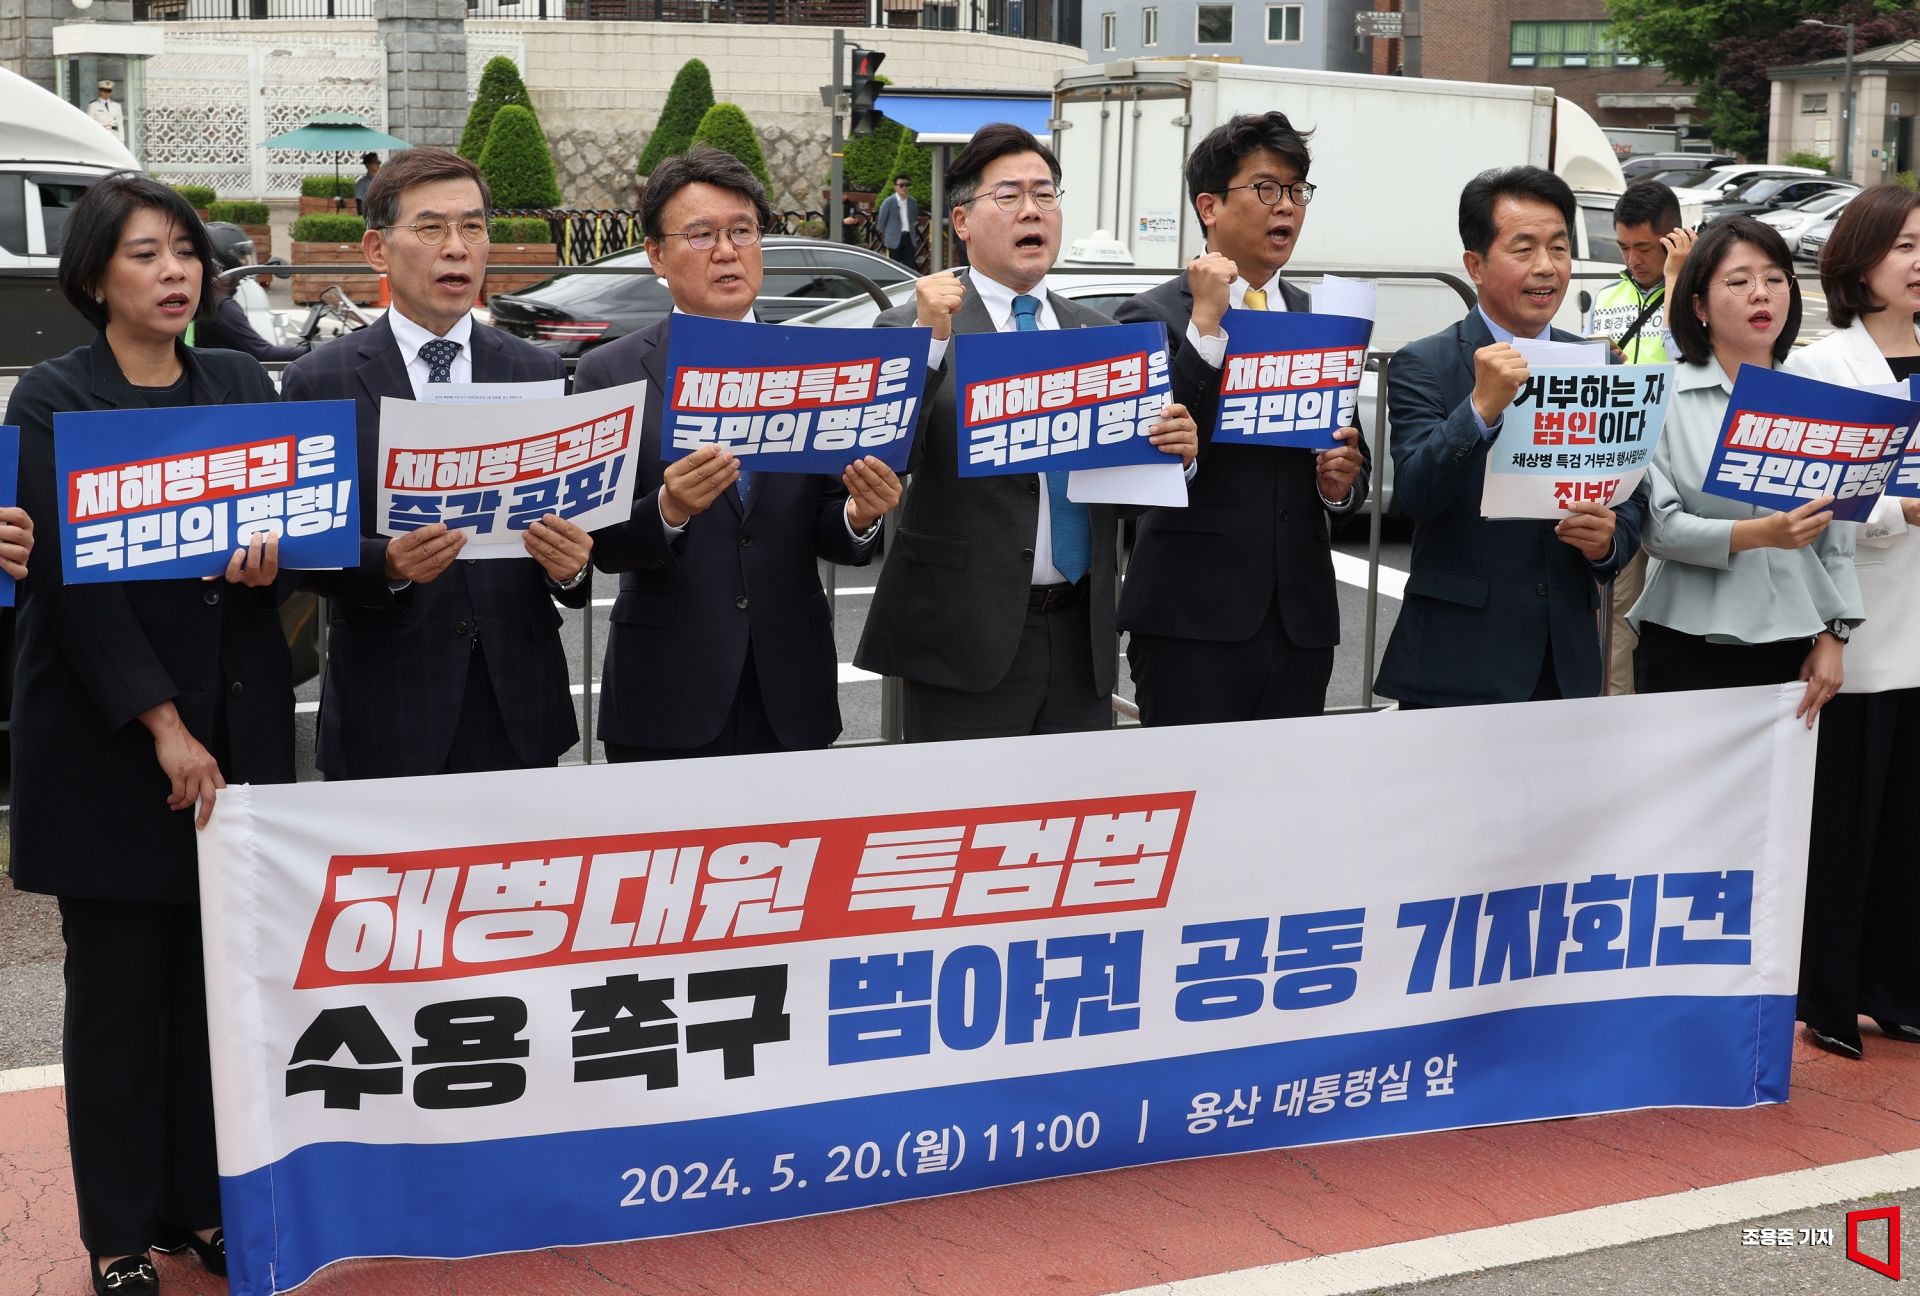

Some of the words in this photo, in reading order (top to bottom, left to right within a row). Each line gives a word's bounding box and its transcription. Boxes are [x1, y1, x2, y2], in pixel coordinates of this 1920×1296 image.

[677, 357, 911, 408] 채해병특검은
[970, 350, 1169, 422] 채해병특검은
[1513, 374, 1636, 410] 거부하는
[1642, 373, 1665, 405] 자
[673, 411, 812, 456] 국민의
[813, 397, 917, 450] 명령!
[970, 408, 1092, 466] 국민의
[1221, 390, 1333, 435] 국민의
[1533, 410, 1646, 445] 범인이다
[1730, 413, 1909, 458] 채해병특검은
[75, 434, 335, 518] 채해병특검은
[391, 412, 627, 489] 채해병특검법
[1512, 453, 1552, 468] 채상병
[1556, 453, 1581, 468] 특검
[1584, 452, 1615, 468] 거부권
[1716, 451, 1844, 499] 국민의
[388, 489, 502, 534] 즉각
[507, 454, 626, 530] 공포!
[76, 502, 228, 571] 국민의
[237, 480, 351, 547] 명령!
[325, 837, 822, 973] 해병대원
[847, 808, 1181, 921] 특검법
[285, 996, 530, 1111] 수용
[570, 963, 791, 1091] 촉구
[828, 929, 1144, 1066] 범야권
[1175, 907, 1366, 1022] 공동
[1397, 870, 1754, 995] 기자회견
[620, 1158, 751, 1207] 2024.
[769, 1152, 808, 1193] 5.
[825, 1124, 966, 1184] 20.(월)
[983, 1111, 1100, 1162] 11:00
[1186, 1085, 1261, 1135] 용산
[1273, 1060, 1412, 1117] 대통령실
[1424, 1053, 1457, 1098] 앞
